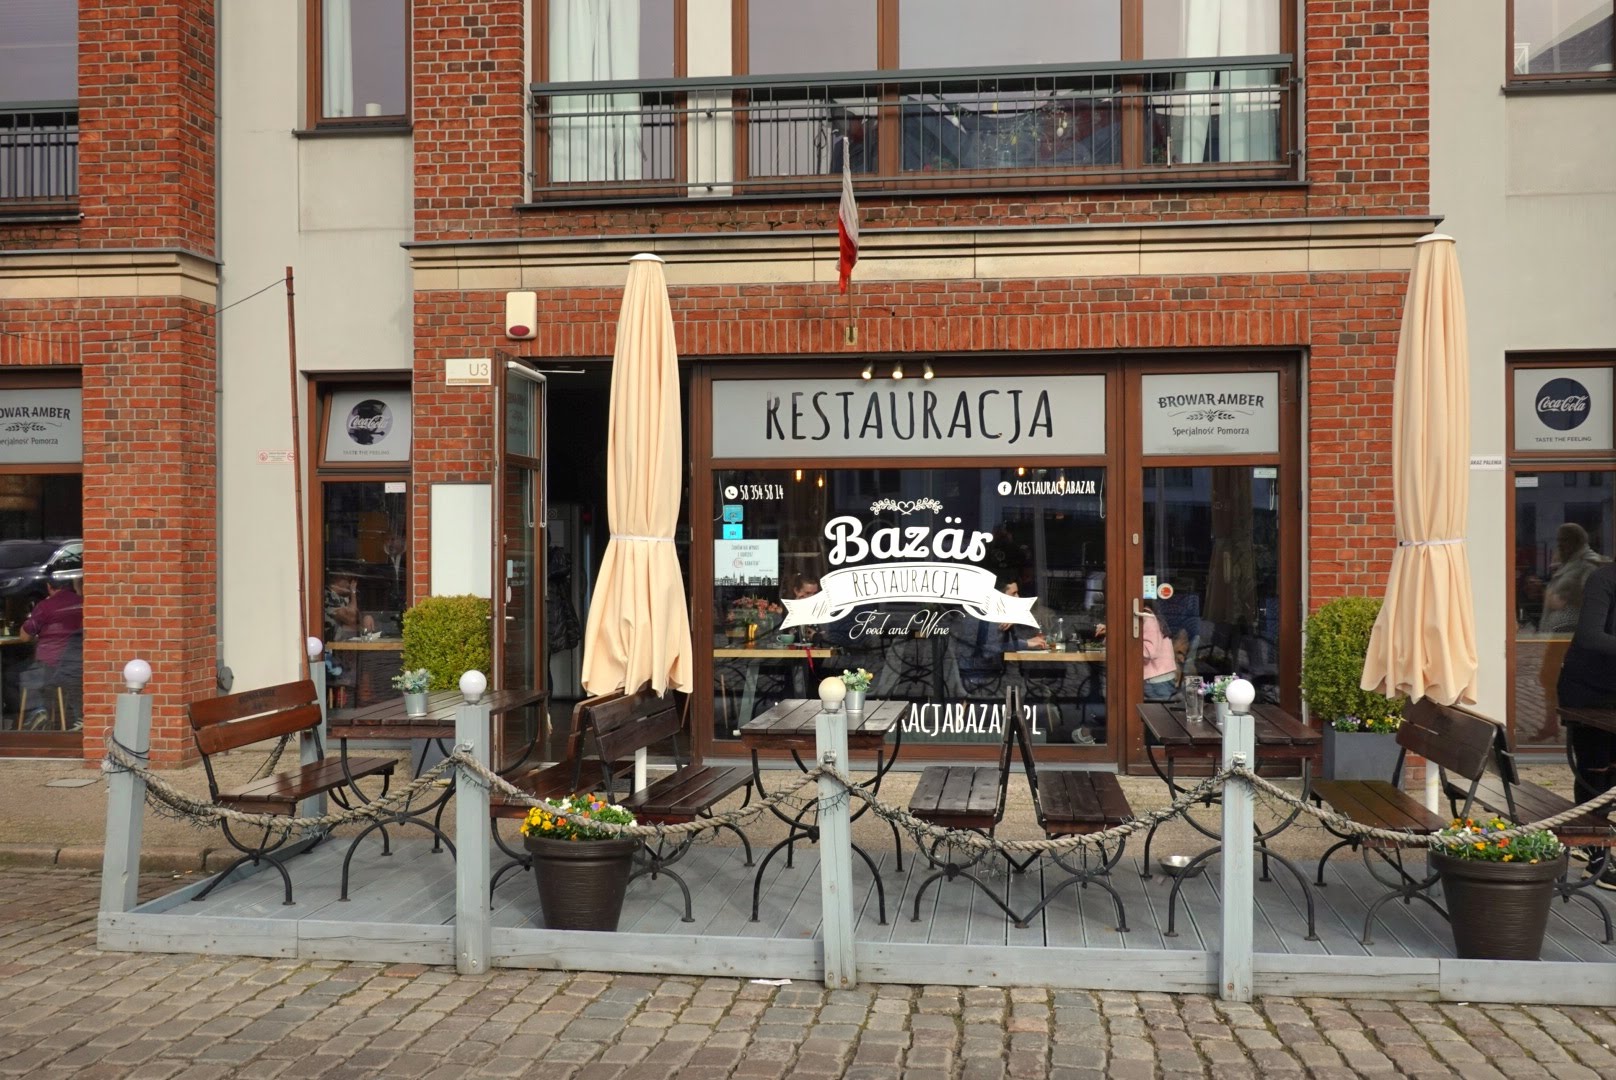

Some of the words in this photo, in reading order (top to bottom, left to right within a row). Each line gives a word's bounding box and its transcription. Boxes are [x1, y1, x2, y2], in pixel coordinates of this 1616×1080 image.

[469, 363, 489, 376] U3
[1158, 393, 1216, 409] BROWAR
[1217, 393, 1264, 408] AMBER
[31, 406, 71, 420] AMBER
[766, 389, 1054, 444] RESTAURACJA
[1172, 426, 1214, 437] Specjalność
[1217, 426, 1250, 435] Pomorza
[31, 437, 59, 445] Pomorza
[740, 485, 749, 500] 58
[750, 485, 763, 500] 354
[764, 485, 774, 500] 58
[775, 485, 784, 500] 14
[852, 569, 960, 598] RESTAURACJA
[849, 609, 891, 639] Food
[888, 614, 916, 635] and
[914, 609, 966, 639] Wine
